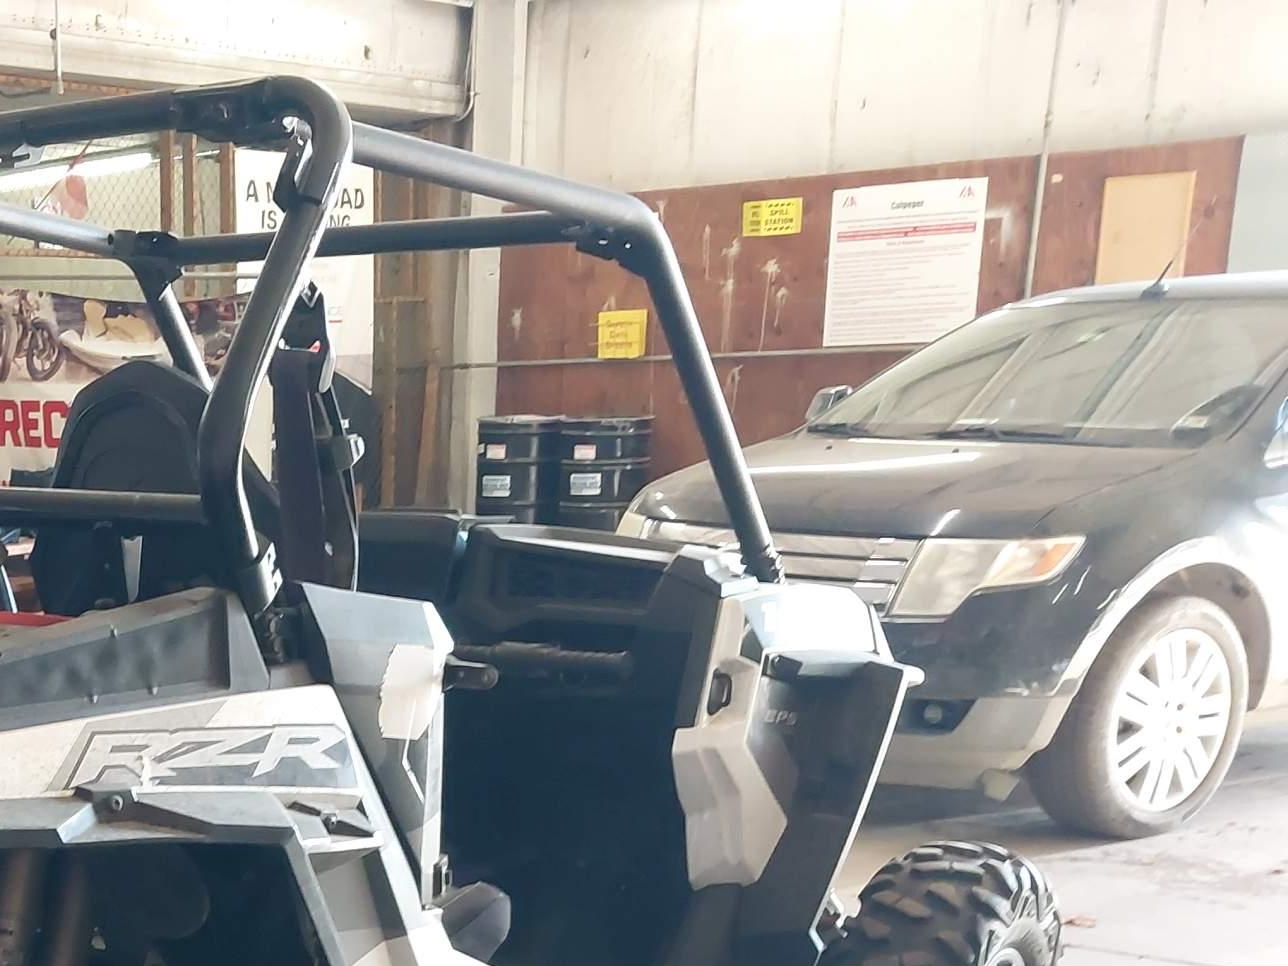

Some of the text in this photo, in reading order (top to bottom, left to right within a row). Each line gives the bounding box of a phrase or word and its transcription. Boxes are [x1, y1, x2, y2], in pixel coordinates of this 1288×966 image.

[246, 179, 259, 203] A
[261, 210, 278, 230] IS
[62, 724, 346, 788] RZR
